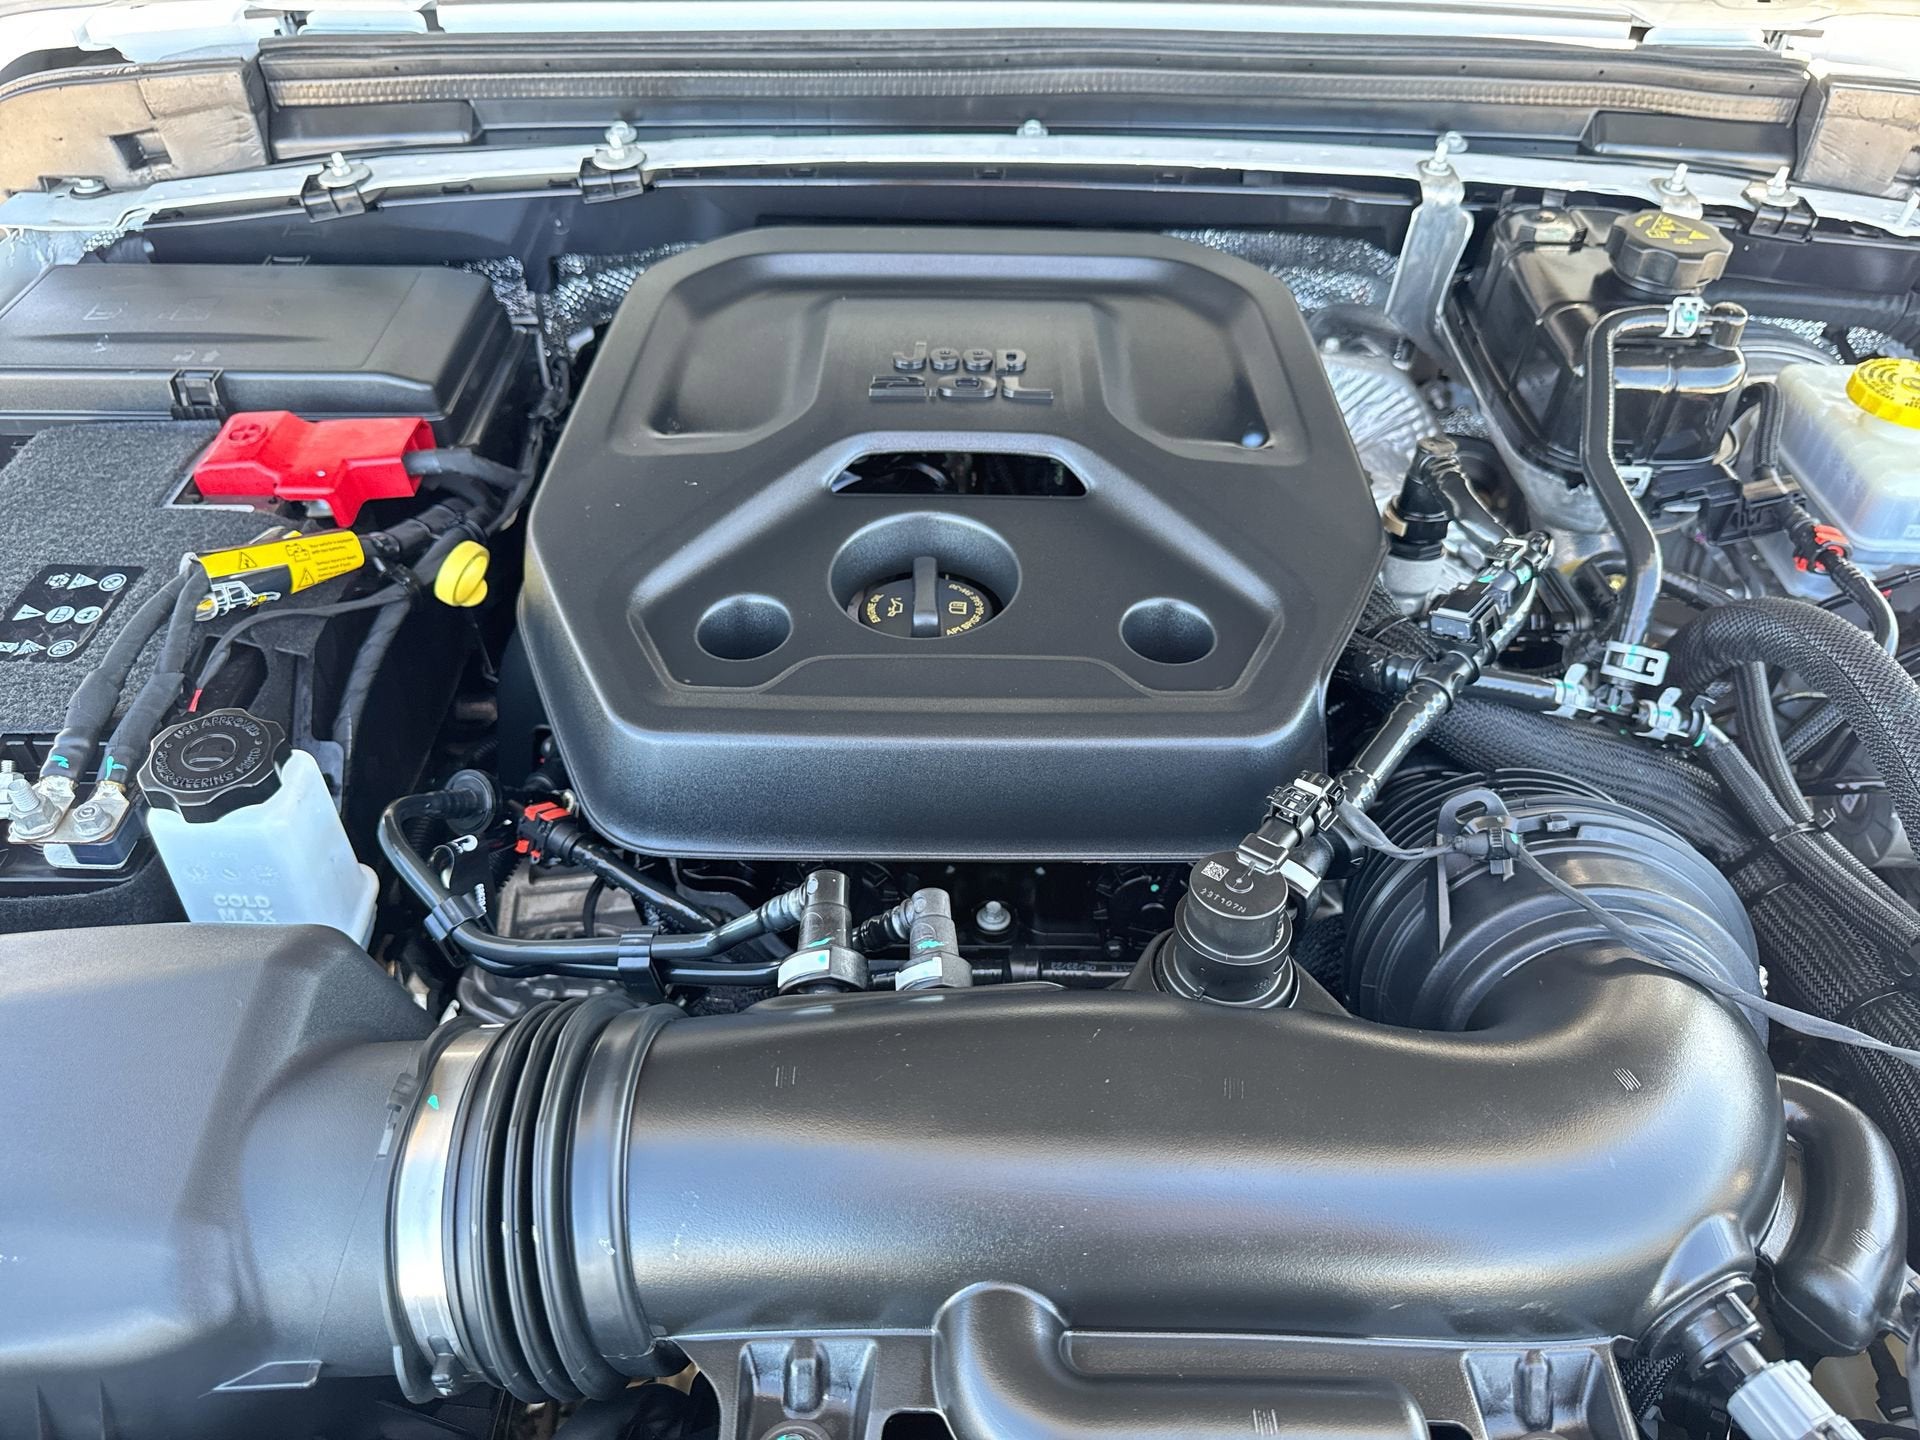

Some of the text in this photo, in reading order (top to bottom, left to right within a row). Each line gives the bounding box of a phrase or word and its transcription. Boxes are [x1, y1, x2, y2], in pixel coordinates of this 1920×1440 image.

[892, 341, 1027, 375] Jeep
[868, 375, 1054, 401] 2.0L
[173, 716, 261, 739] USE APPROVED
[173, 771, 235, 789] STEERING
[213, 893, 271, 908] COLD
[217, 907, 276, 922] MAX
